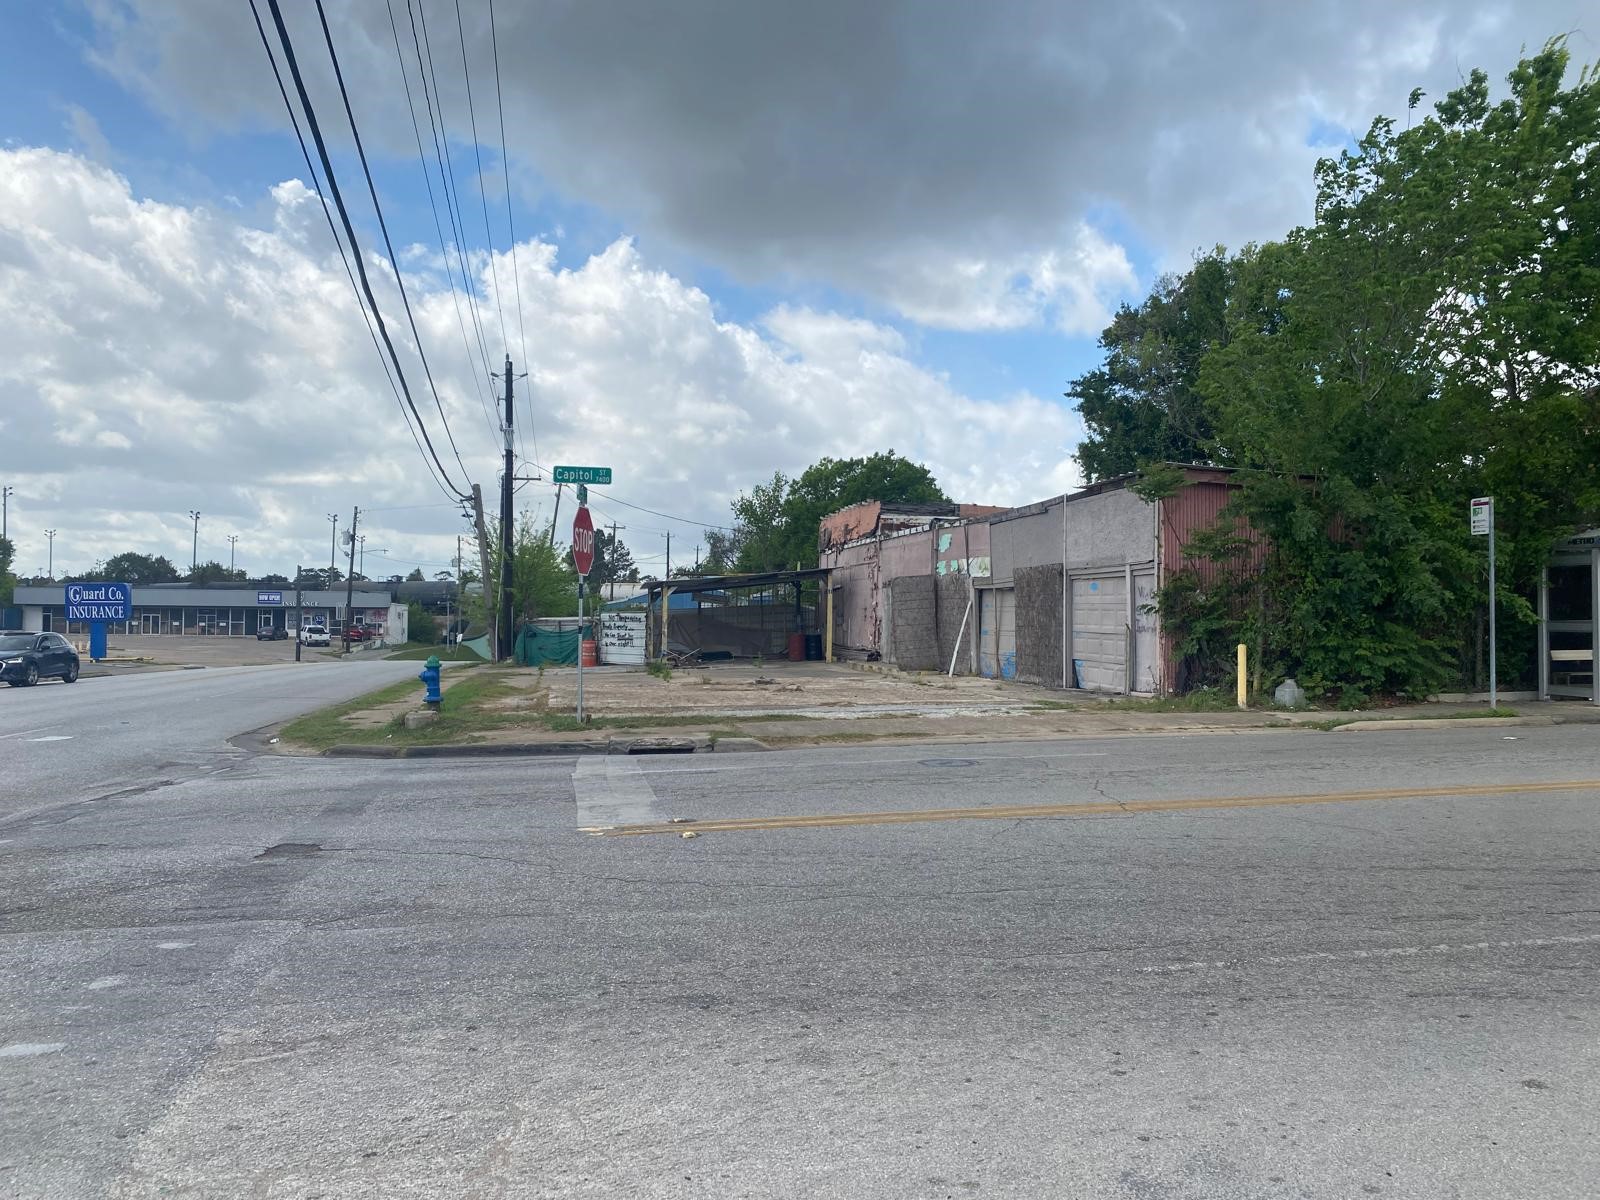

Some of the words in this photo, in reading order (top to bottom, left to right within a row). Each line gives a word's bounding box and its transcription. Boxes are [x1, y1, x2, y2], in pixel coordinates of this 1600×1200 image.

[556, 469, 593, 482] Capitol
[574, 527, 593, 554] STOP
[70, 586, 105, 601] Guard
[108, 586, 124, 600] Co.
[69, 605, 125, 619] INSURANCE
